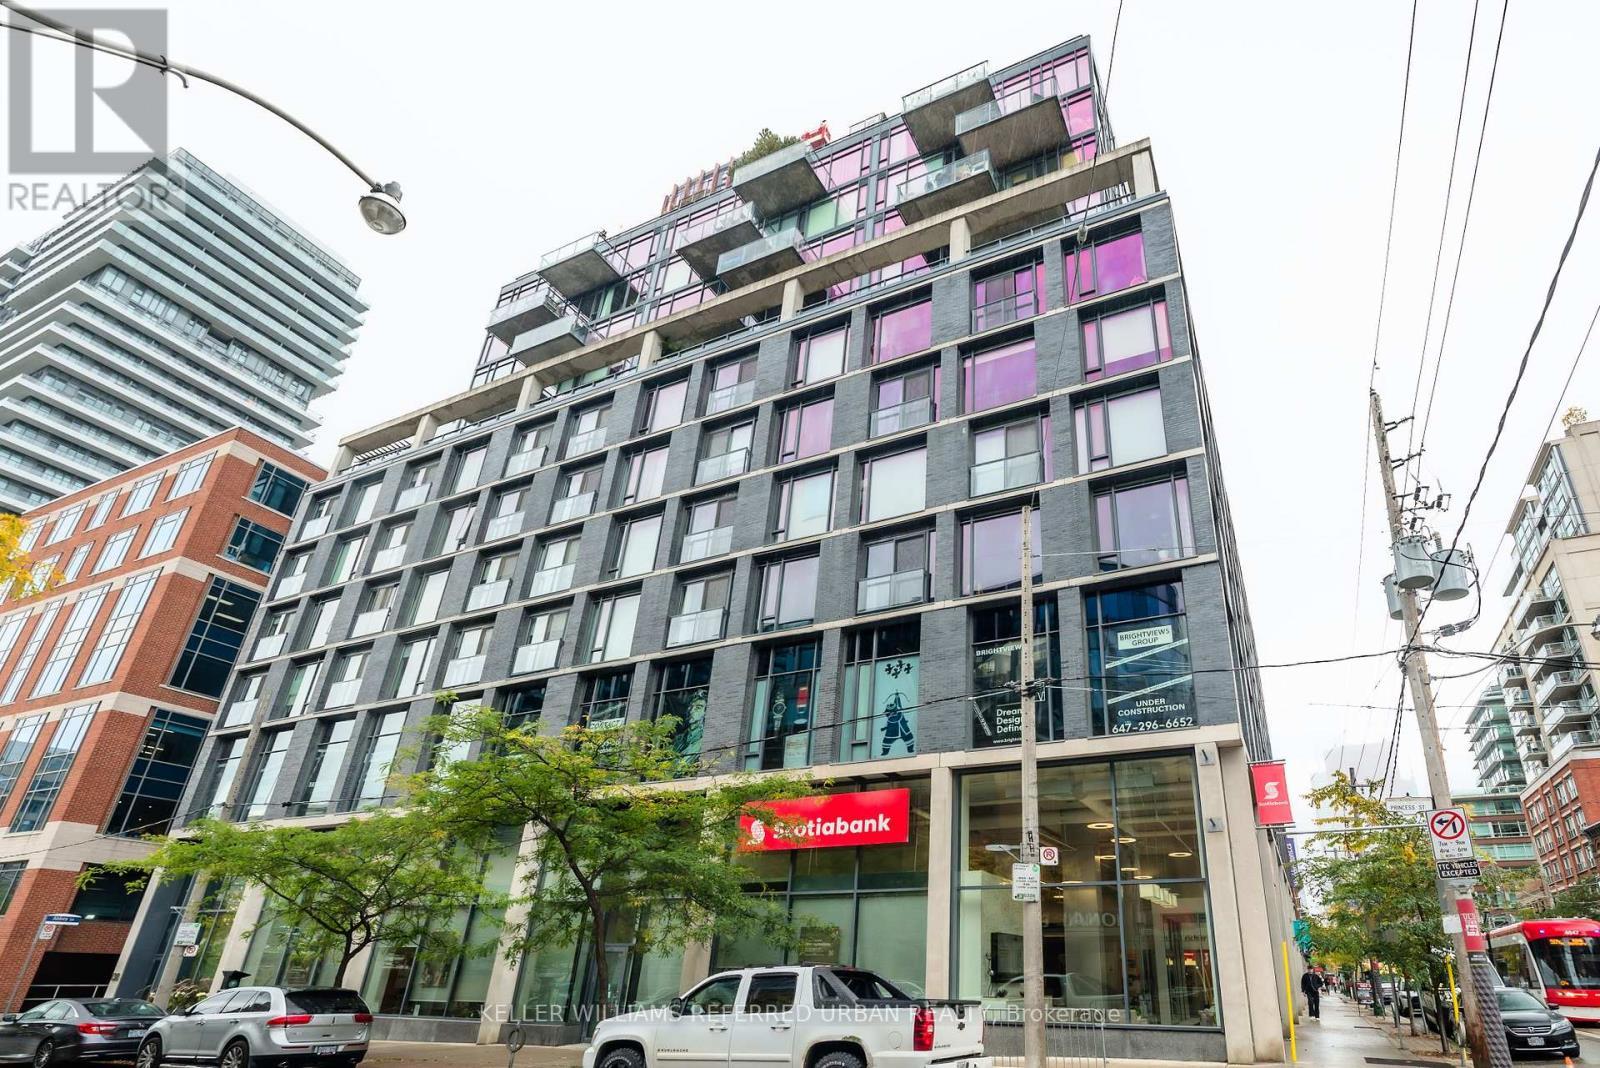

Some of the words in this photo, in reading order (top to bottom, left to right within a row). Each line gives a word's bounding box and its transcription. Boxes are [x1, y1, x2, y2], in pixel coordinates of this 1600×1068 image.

[1119, 627, 1170, 641] BRIGHTVIEWS
[1131, 637, 1159, 647] GROUP
[975, 644, 1022, 656] BRIGHTVIEW
[1135, 698, 1166, 708] UNDER
[1118, 703, 1185, 717] CONSTRUCTION
[996, 716, 1022, 725] Desig
[1111, 717, 1194, 734] 647-296-6652
[1451, 861, 1477, 870] VEHICLES
[1441, 869, 1478, 877] EXCEPTED
